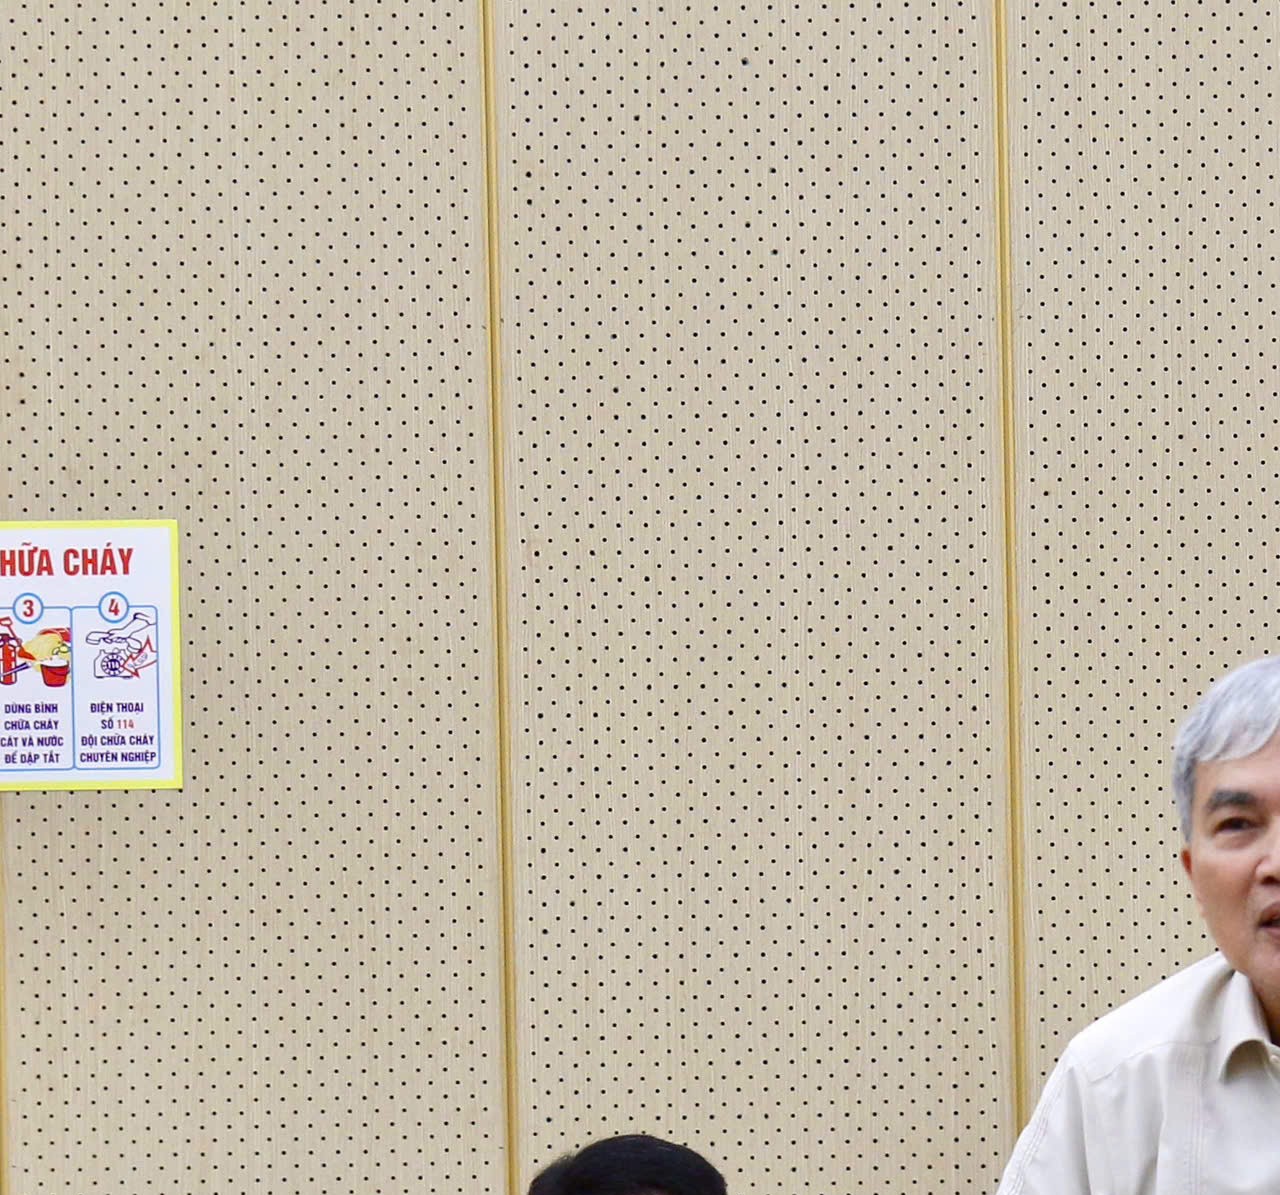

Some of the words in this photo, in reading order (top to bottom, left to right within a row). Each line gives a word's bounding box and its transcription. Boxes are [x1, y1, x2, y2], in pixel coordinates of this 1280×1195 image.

[63, 542, 133, 576] CHÁY
[22, 599, 34, 617] 3
[108, 598, 119, 616] 4
[4, 701, 31, 714] DÙNG
[34, 701, 58, 714] BÌNH
[90, 701, 113, 715] ĐIỆN
[116, 702, 144, 715] THOẠI
[4, 718, 31, 731] CHỮA
[33, 718, 59, 730] CHÁY
[101, 716, 114, 729] SỐ
[117, 719, 134, 729] 114
[0, 735, 18, 747] CÁT
[21, 735, 34, 747] VÀ
[81, 734, 98, 748] ĐỘI
[100, 733, 126, 746] CHỮA
[129, 734, 154, 746] CHÁY
[80, 750, 118, 763] CHUYÊN
[120, 749, 156, 764] NGHIỆP
